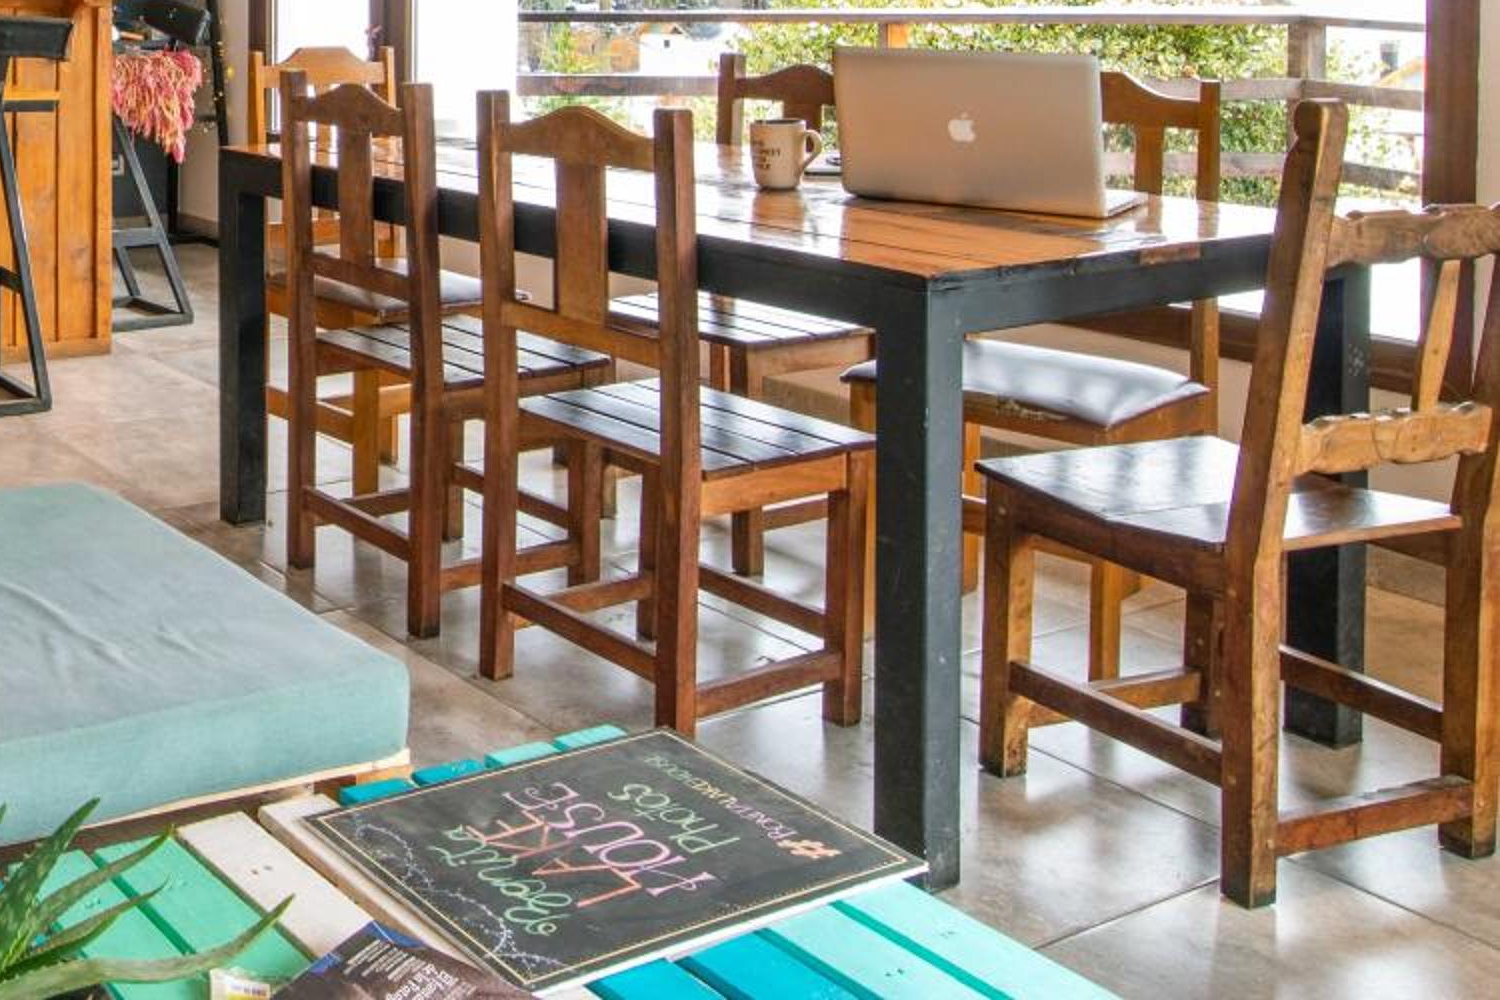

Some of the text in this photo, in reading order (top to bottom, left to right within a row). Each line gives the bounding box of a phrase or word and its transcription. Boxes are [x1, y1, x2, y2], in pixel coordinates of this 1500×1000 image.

[465, 807, 642, 908] LAKE
[502, 781, 716, 897] HOUSE
[607, 783, 741, 854] Photos
[429, 824, 572, 936] Bonita
